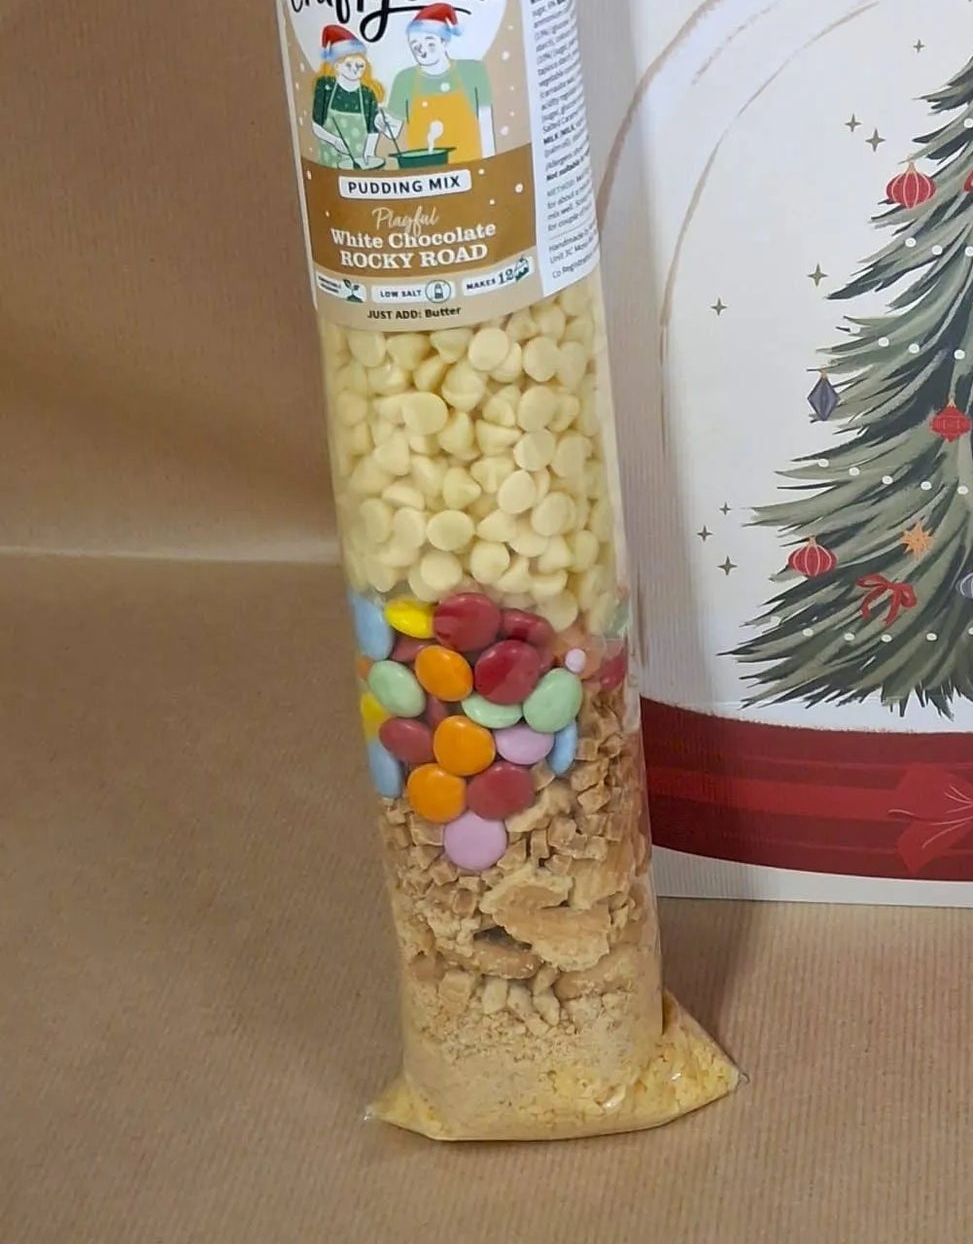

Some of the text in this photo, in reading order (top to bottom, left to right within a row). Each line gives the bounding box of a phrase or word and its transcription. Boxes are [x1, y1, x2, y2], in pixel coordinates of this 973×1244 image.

[348, 175, 460, 195] PUDDING MIX
[372, 205, 440, 237] Playful
[330, 223, 497, 249] White Chocolate
[340, 244, 488, 269] ROCKY ROAD
[466, 269, 514, 291] MAKES 12
[380, 289, 421, 298] LOW SALT
[367, 306, 461, 320] JUST ADD: Butter
